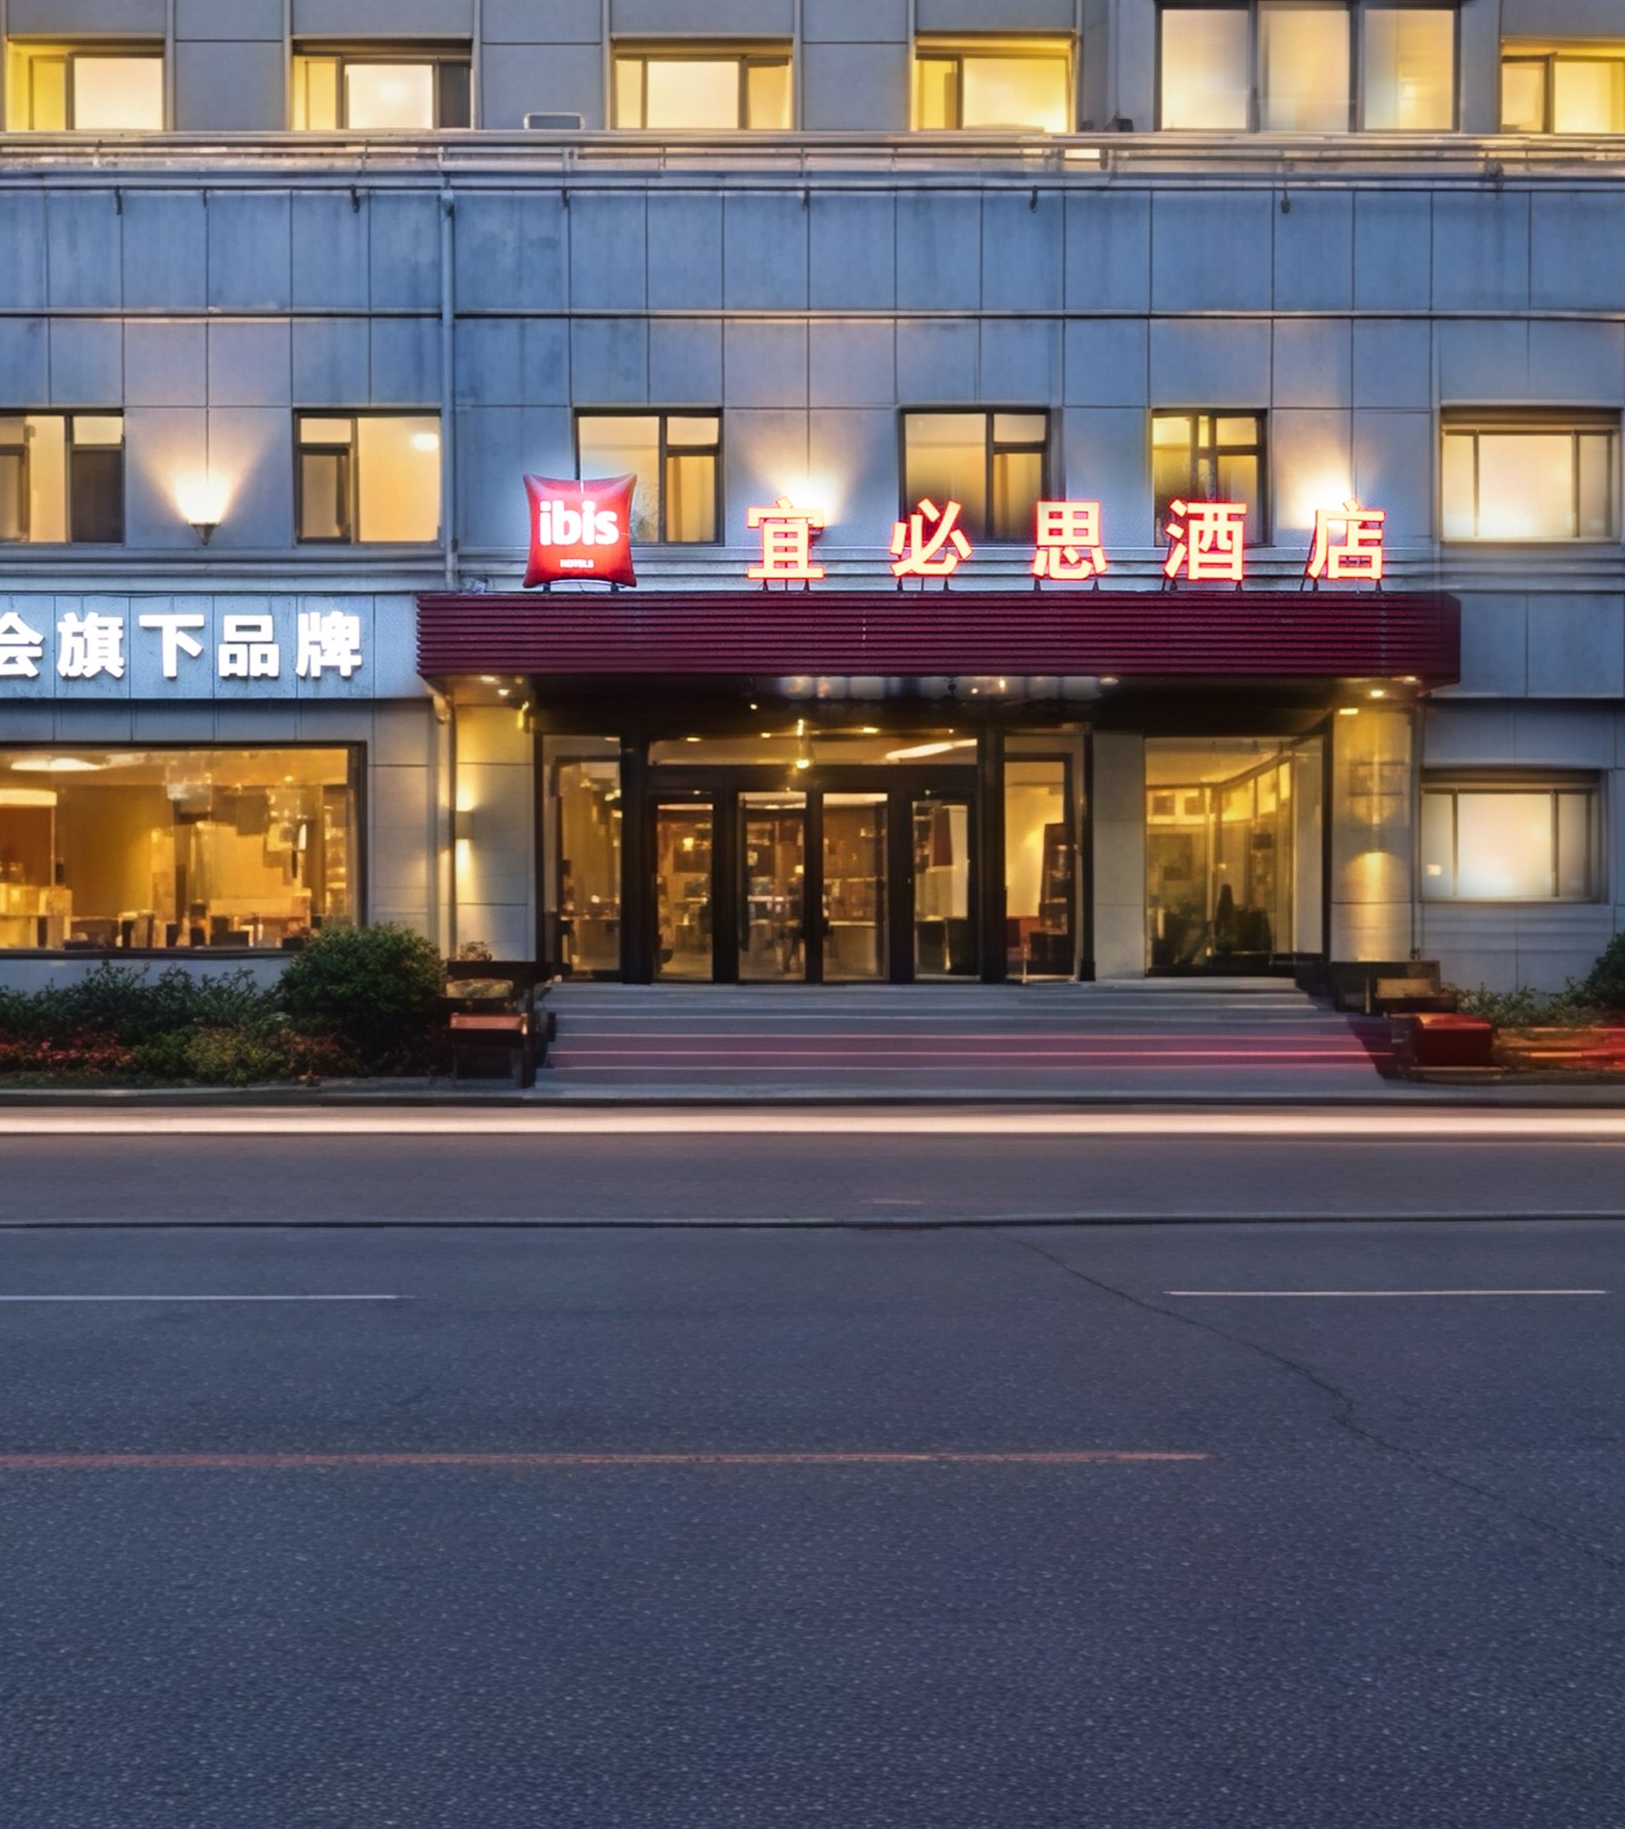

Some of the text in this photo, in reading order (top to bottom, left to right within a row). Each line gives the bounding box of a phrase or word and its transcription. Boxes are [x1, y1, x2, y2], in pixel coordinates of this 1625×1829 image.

[539, 500, 619, 546] ibis
[747, 498, 1386, 581] 宜必思酒店
